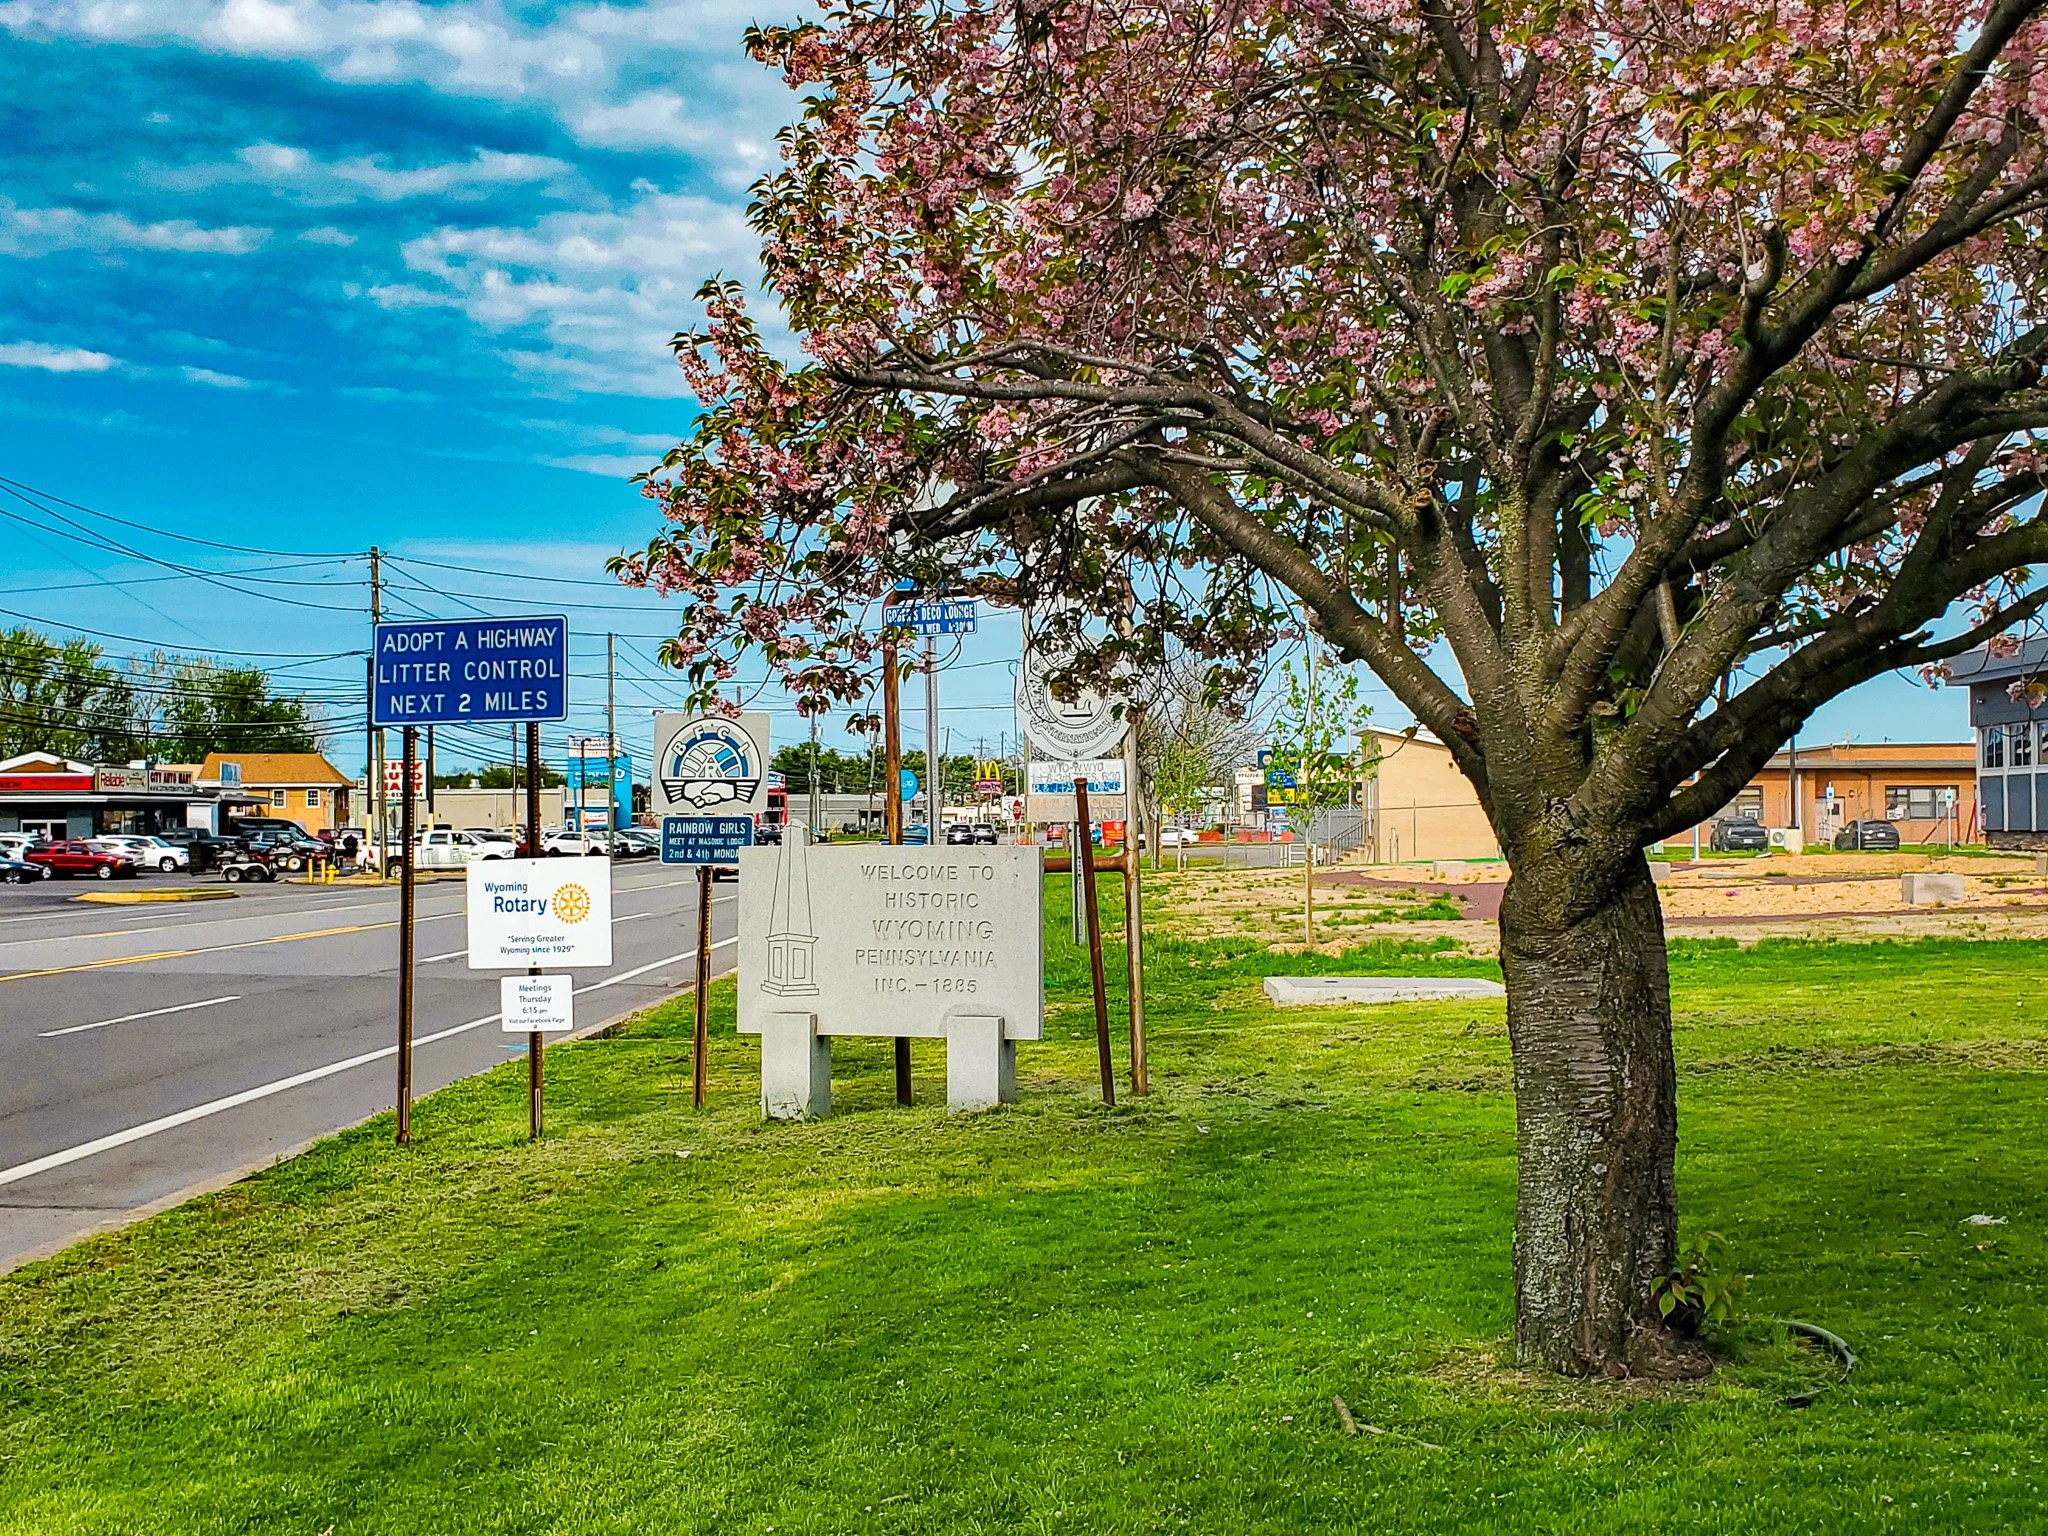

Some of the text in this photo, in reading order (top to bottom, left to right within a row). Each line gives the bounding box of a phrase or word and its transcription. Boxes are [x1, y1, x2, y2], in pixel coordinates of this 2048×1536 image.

[887, 603, 974, 623] GOBERS DECO LOUNGE
[926, 622, 943, 634] WED.
[382, 627, 558, 653] ADOPT A HIGHWAY
[379, 659, 560, 684] LITTER CONTROL
[390, 690, 548, 714] NEXT 2 MILES
[669, 822, 746, 834] RAINBOW GIRLS
[669, 837, 745, 845] MEET AT MASONIC LODGE
[668, 848, 739, 860] 2nd & 4th MONDA
[860, 865, 994, 881] WELCOME TO
[484, 882, 528, 894] Wyoming
[494, 896, 548, 915] Rotary
[885, 891, 979, 909] HISTORIC
[872, 919, 994, 941] WYOMING
[536, 934, 565, 943] Greater
[500, 946, 530, 955] Wyoming
[855, 949, 997, 968] PENNSYLVANIA
[518, 985, 552, 993] Meetings
[518, 995, 552, 1004] Thursday
[522, 1006, 538, 1014] 6:15
